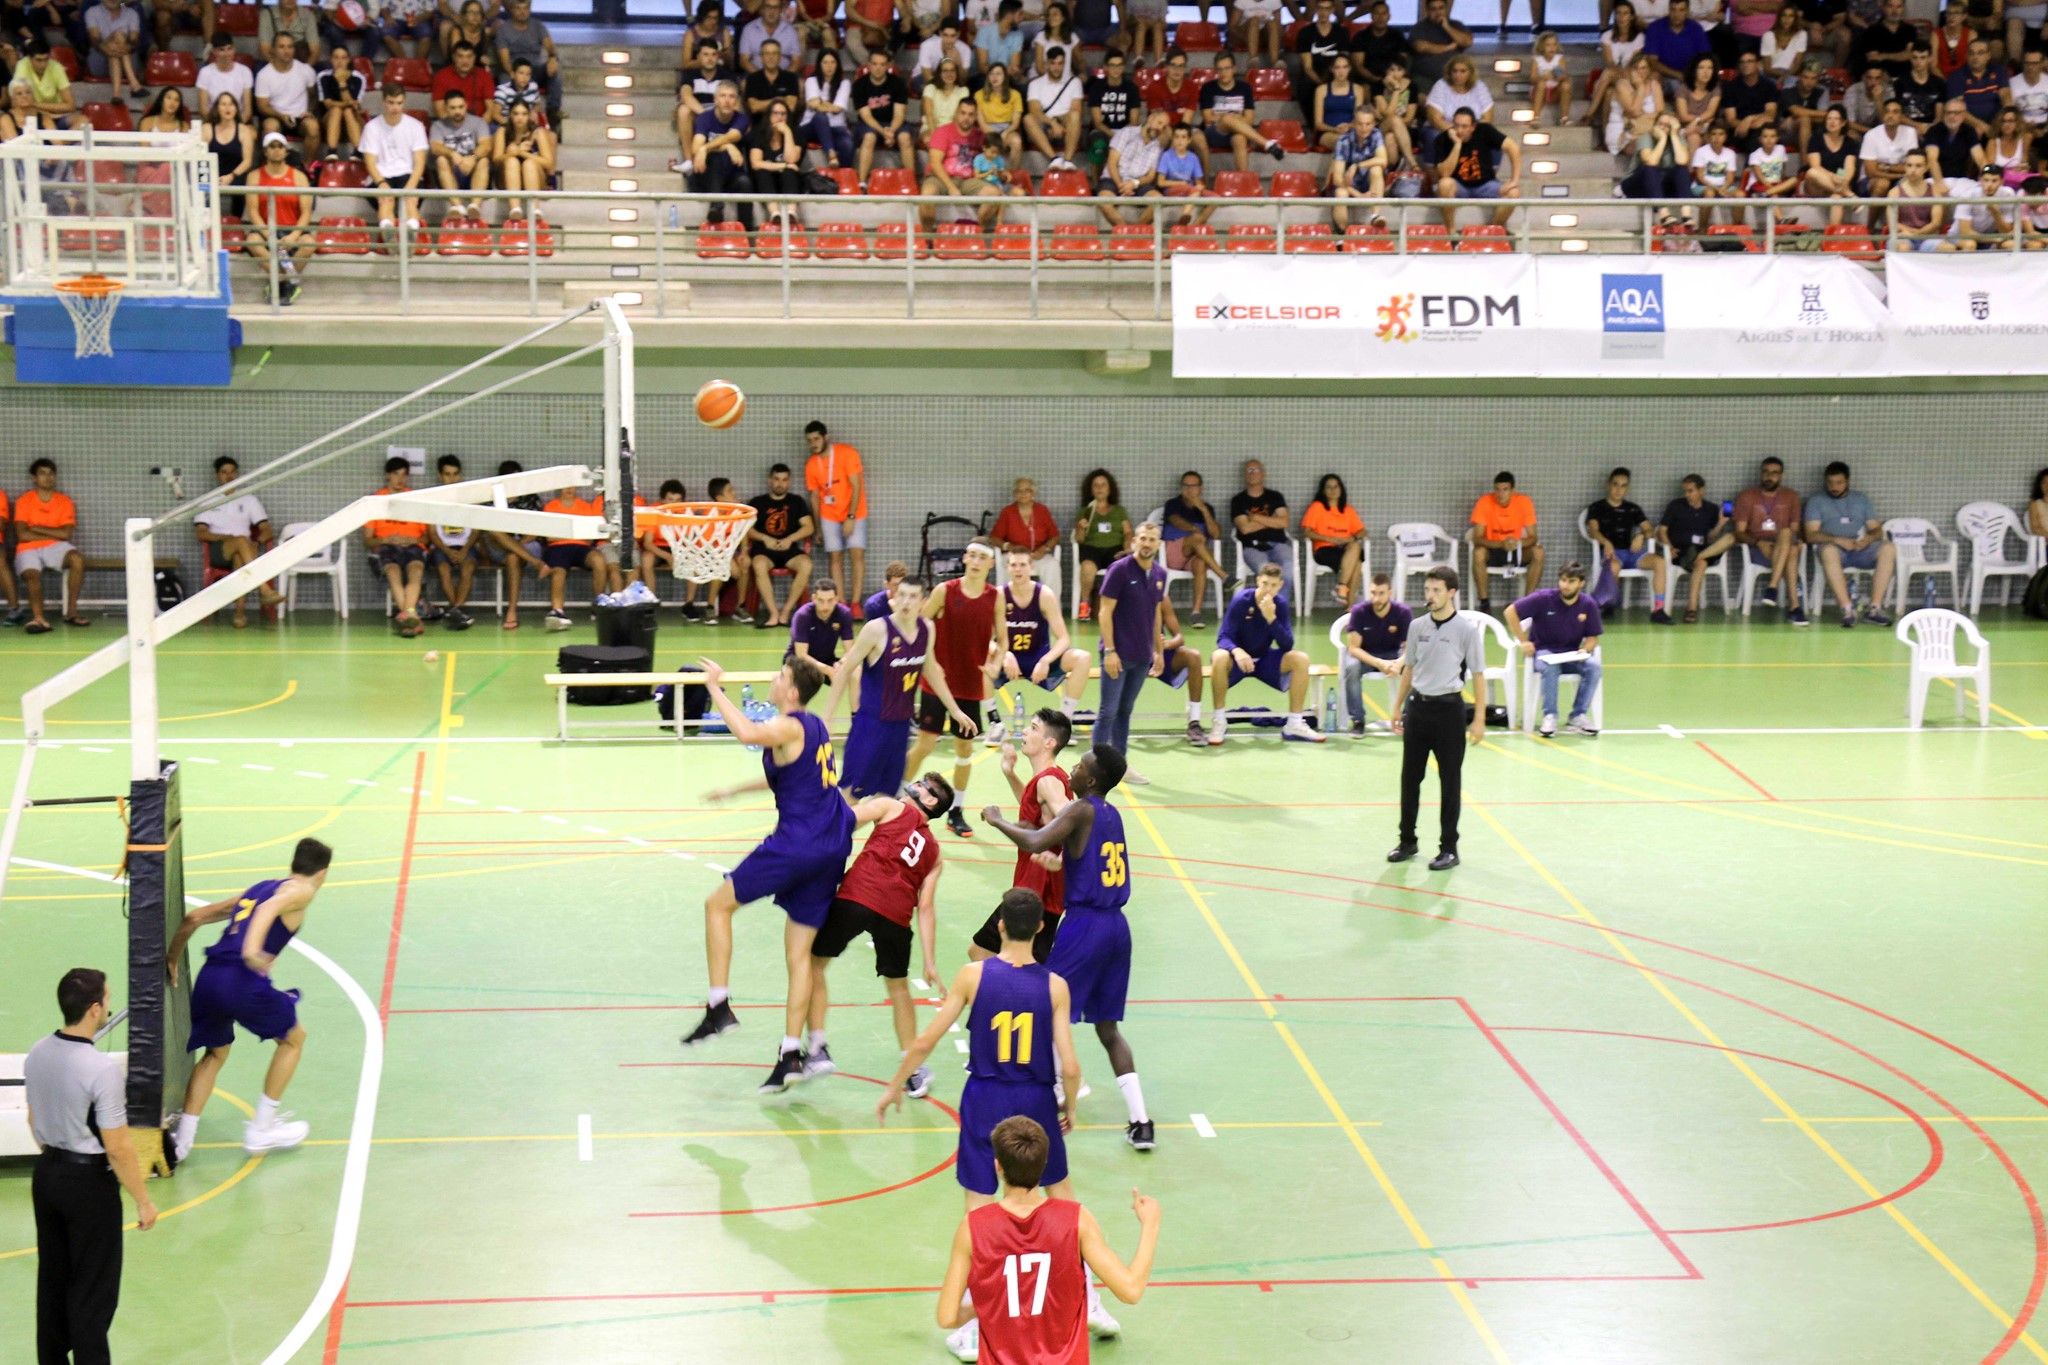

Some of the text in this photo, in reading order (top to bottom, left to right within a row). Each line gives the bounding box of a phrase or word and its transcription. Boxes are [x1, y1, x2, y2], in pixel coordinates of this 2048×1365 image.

[1195, 305, 1341, 320] EXCELSIOR
[1421, 294, 1521, 327] FDM
[1604, 287, 1662, 316] AQA
[1013, 633, 1032, 650] 25
[900, 829, 926, 867] 9
[1100, 840, 1126, 888] 35
[990, 1010, 1034, 1065] 11
[1002, 1251, 1052, 1318] 17
